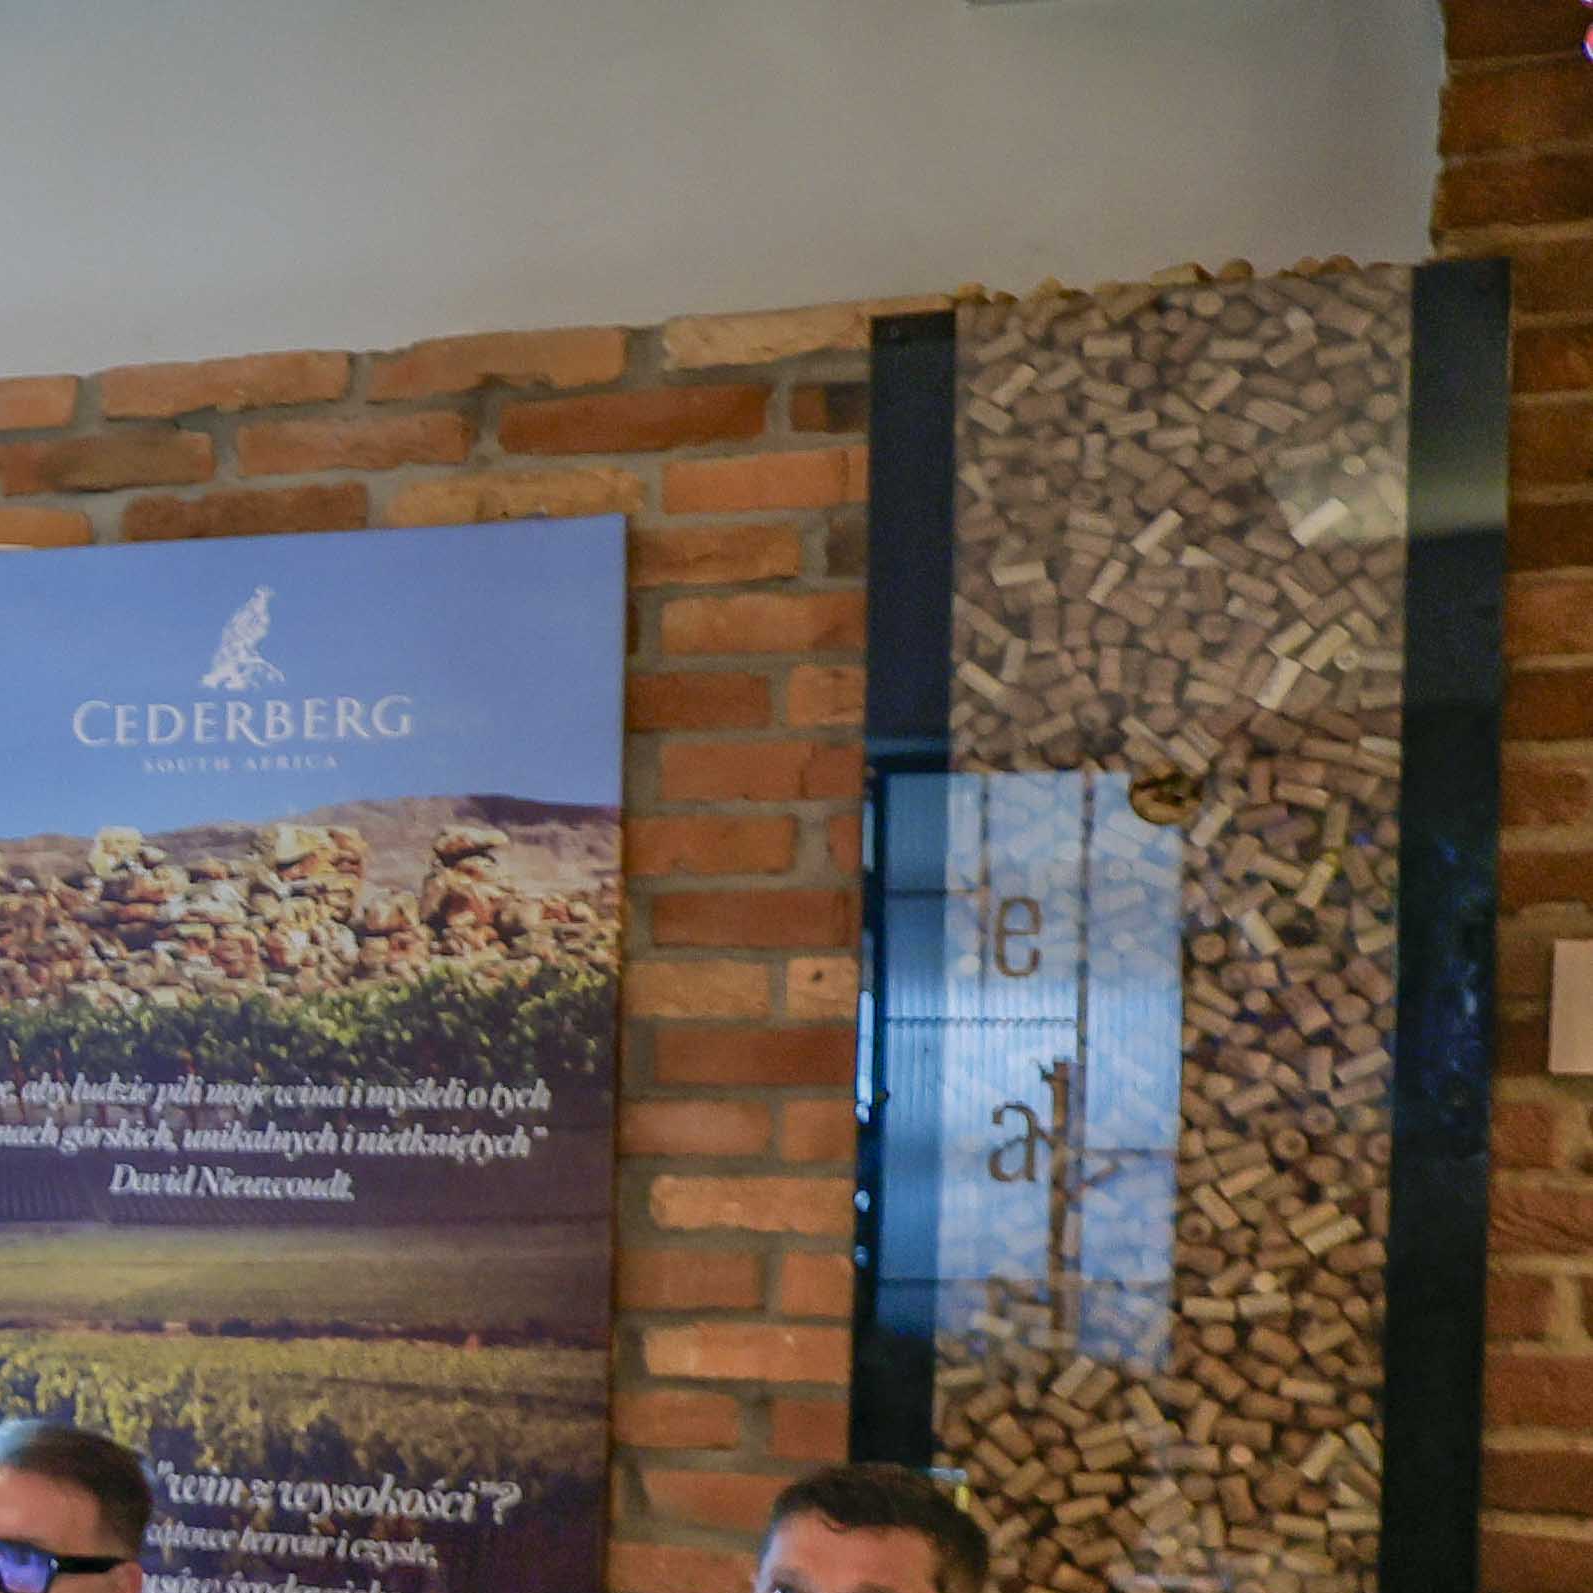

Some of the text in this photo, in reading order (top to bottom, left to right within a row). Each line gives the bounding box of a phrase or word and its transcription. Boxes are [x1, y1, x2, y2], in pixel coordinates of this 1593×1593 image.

[72, 695, 414, 748] CEDERBERG
[467, 1087, 488, 1109] o
[109, 1164, 198, 1196] David
